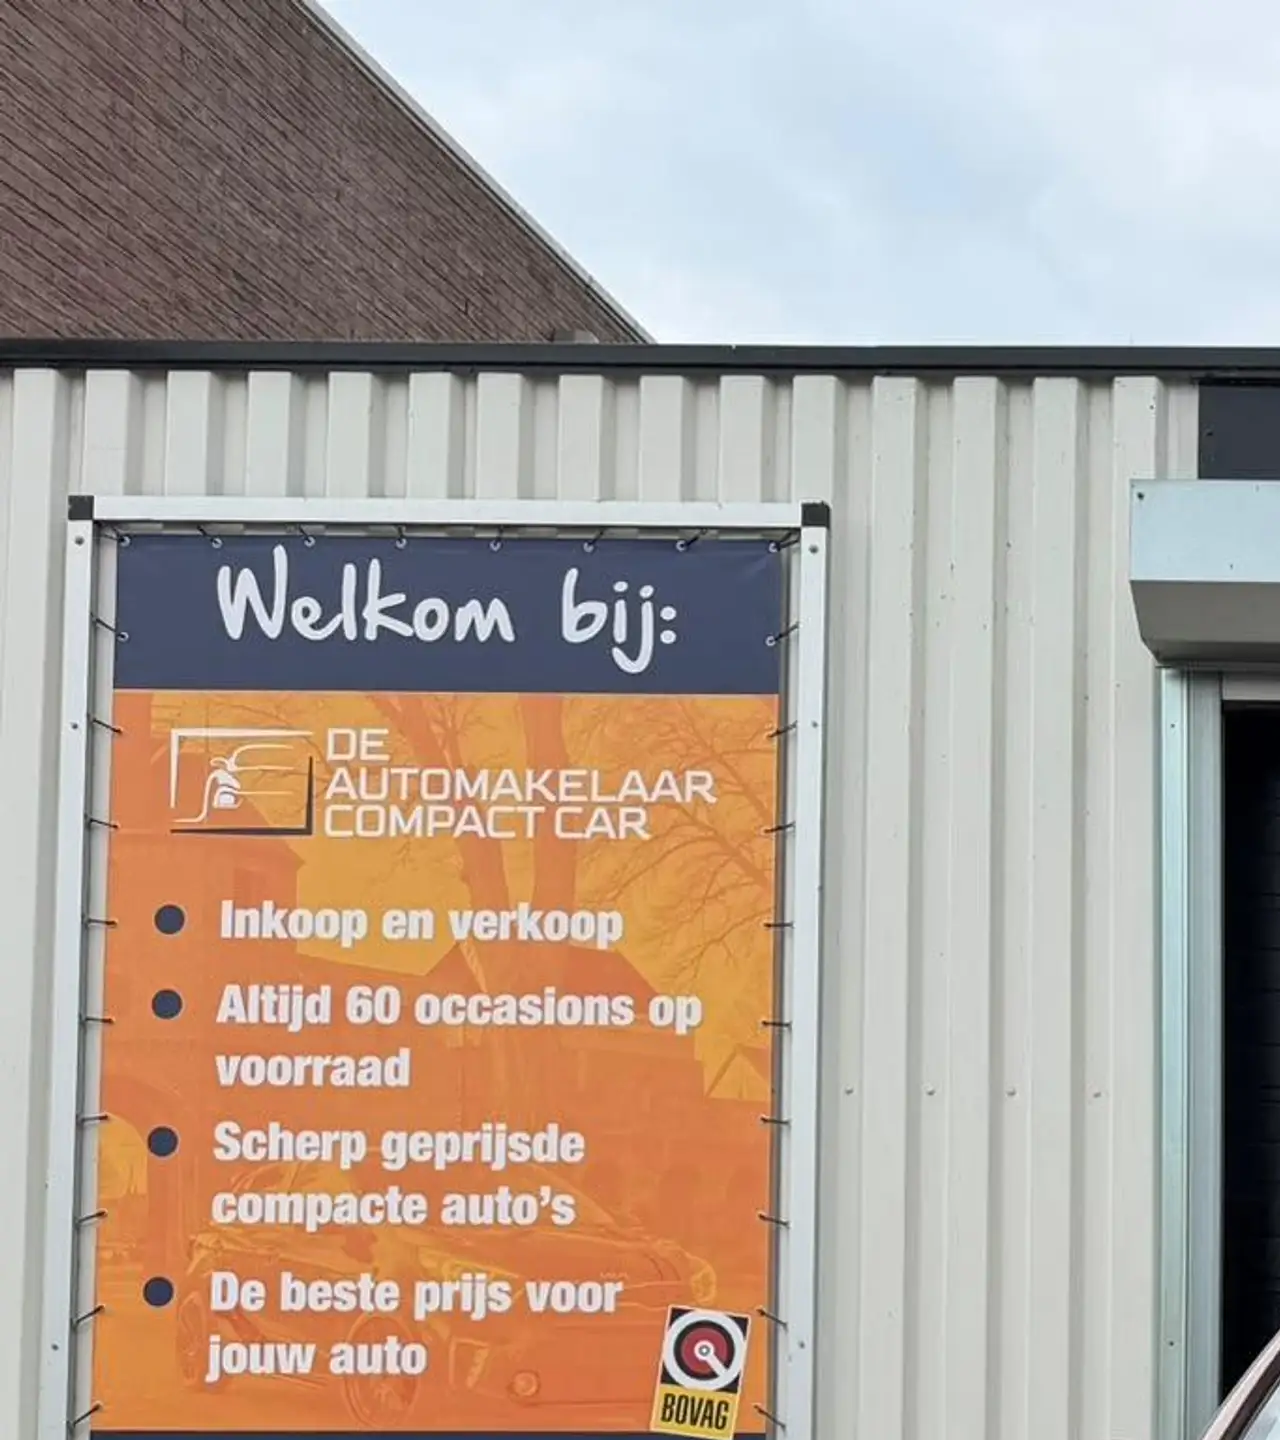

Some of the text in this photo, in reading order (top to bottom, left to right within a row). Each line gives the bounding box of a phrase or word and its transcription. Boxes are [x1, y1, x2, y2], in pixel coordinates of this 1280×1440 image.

[216, 545, 677, 674] Welkom bij:
[326, 728, 389, 761] DE
[325, 768, 717, 804] AUTOMAKELAAR
[324, 805, 650, 839] COMPACT CAR
[220, 900, 624, 948] Inkoop en verkoop
[215, 985, 703, 1035] Altijd 60 occasions op
[216, 1048, 411, 1087] voorraad
[213, 1121, 585, 1171] Scherp geprijsde
[212, 1185, 576, 1233] compacte auto's
[210, 1271, 623, 1321] De beste prijs voor
[205, 1336, 427, 1383] jouw auto
[661, 1392, 731, 1431] BOVAG
